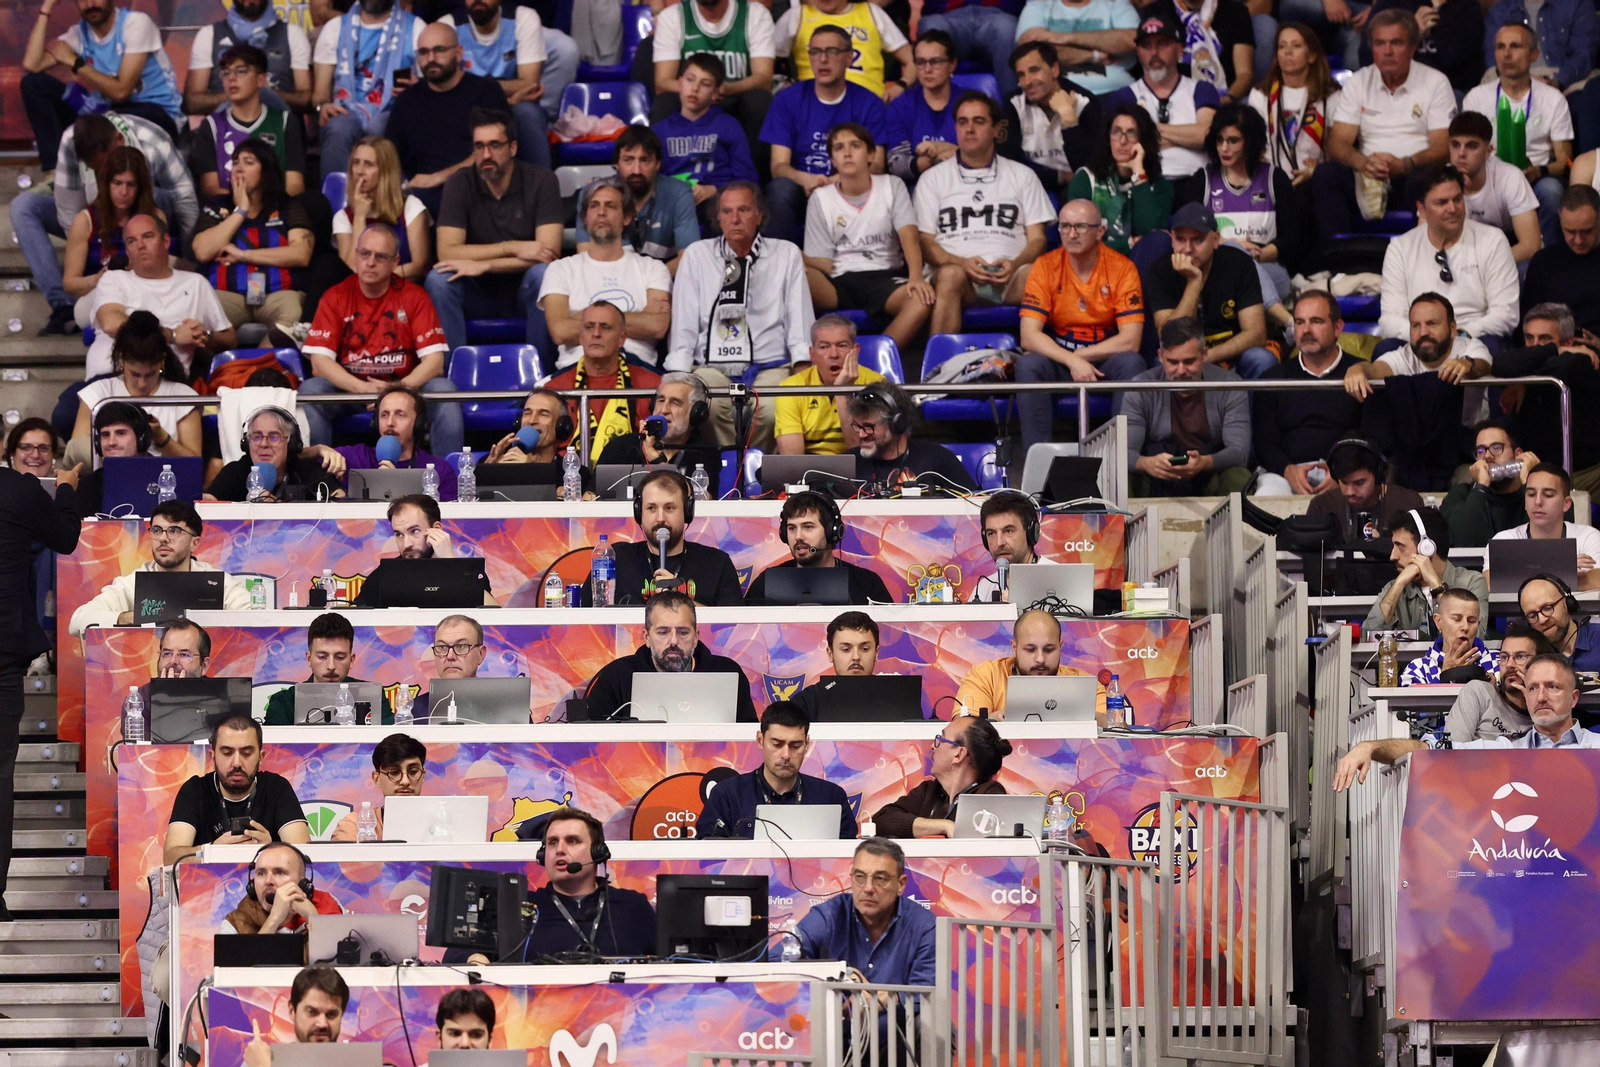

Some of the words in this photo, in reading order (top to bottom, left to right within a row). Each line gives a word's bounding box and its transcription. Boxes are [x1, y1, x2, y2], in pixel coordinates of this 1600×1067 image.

[685, 50, 747, 78] TON
[1234, 225, 1268, 237] Unicaja
[718, 347, 743, 357] 1902
[374, 354, 403, 364] FOUR
[1064, 539, 1095, 552] acb
[1127, 645, 1159, 659] acb
[1194, 764, 1228, 778] acb
[665, 809, 697, 822] acb
[1467, 837, 1568, 862] Andalucía
[768, 895, 794, 905] ivina
[991, 885, 1037, 904] acb
[738, 1027, 795, 1050] acb
